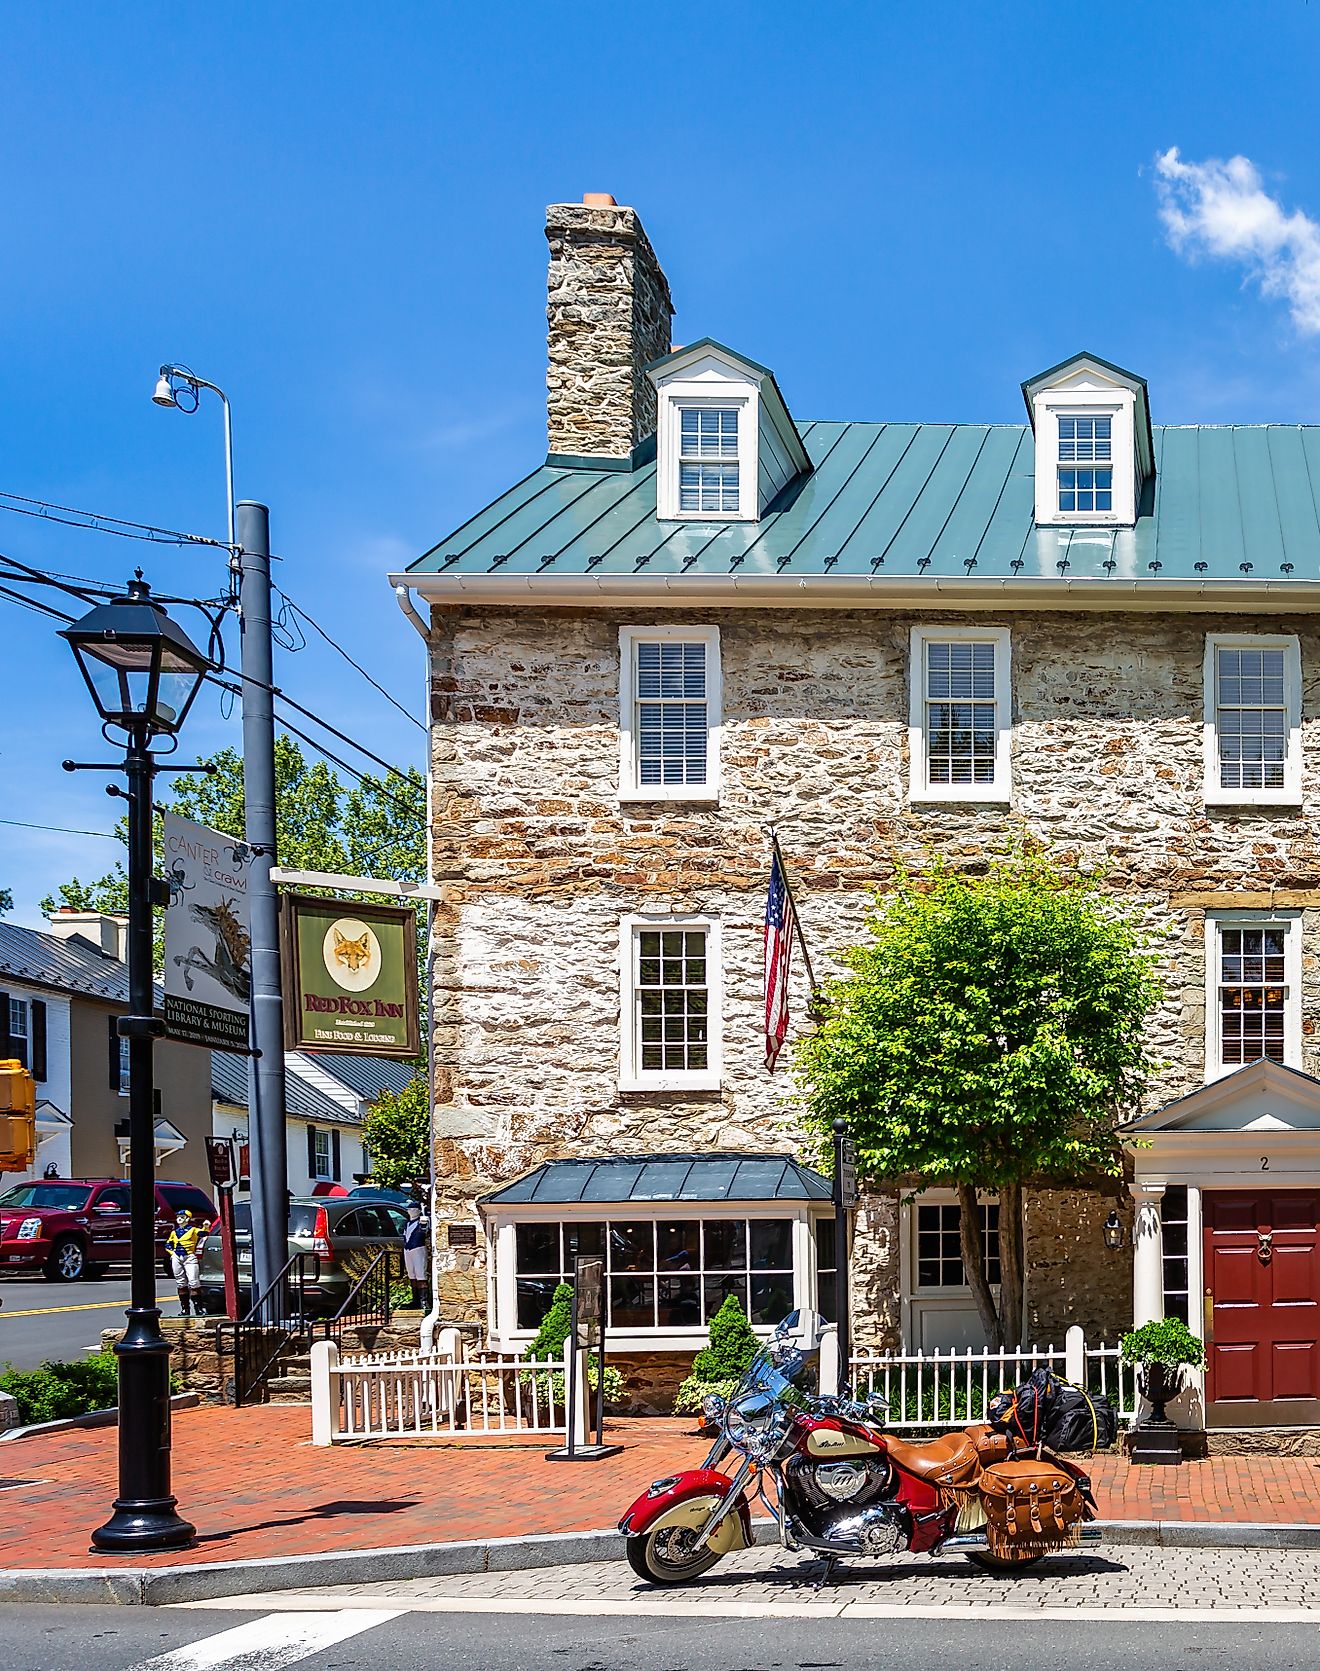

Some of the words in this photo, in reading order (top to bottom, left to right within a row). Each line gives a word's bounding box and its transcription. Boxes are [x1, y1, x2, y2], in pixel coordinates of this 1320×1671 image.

[168, 836, 219, 865] CANTER
[214, 870, 247, 889] crawl
[167, 999, 207, 1017] NATIONAL
[209, 1009, 246, 1026] SPORTING
[167, 1009, 202, 1026] LIBRARY
[203, 1018, 210, 1029] &
[211, 1020, 246, 1037] MUSEUM
[354, 1032, 364, 1041] &
[1260, 1156, 1270, 1171] 2
